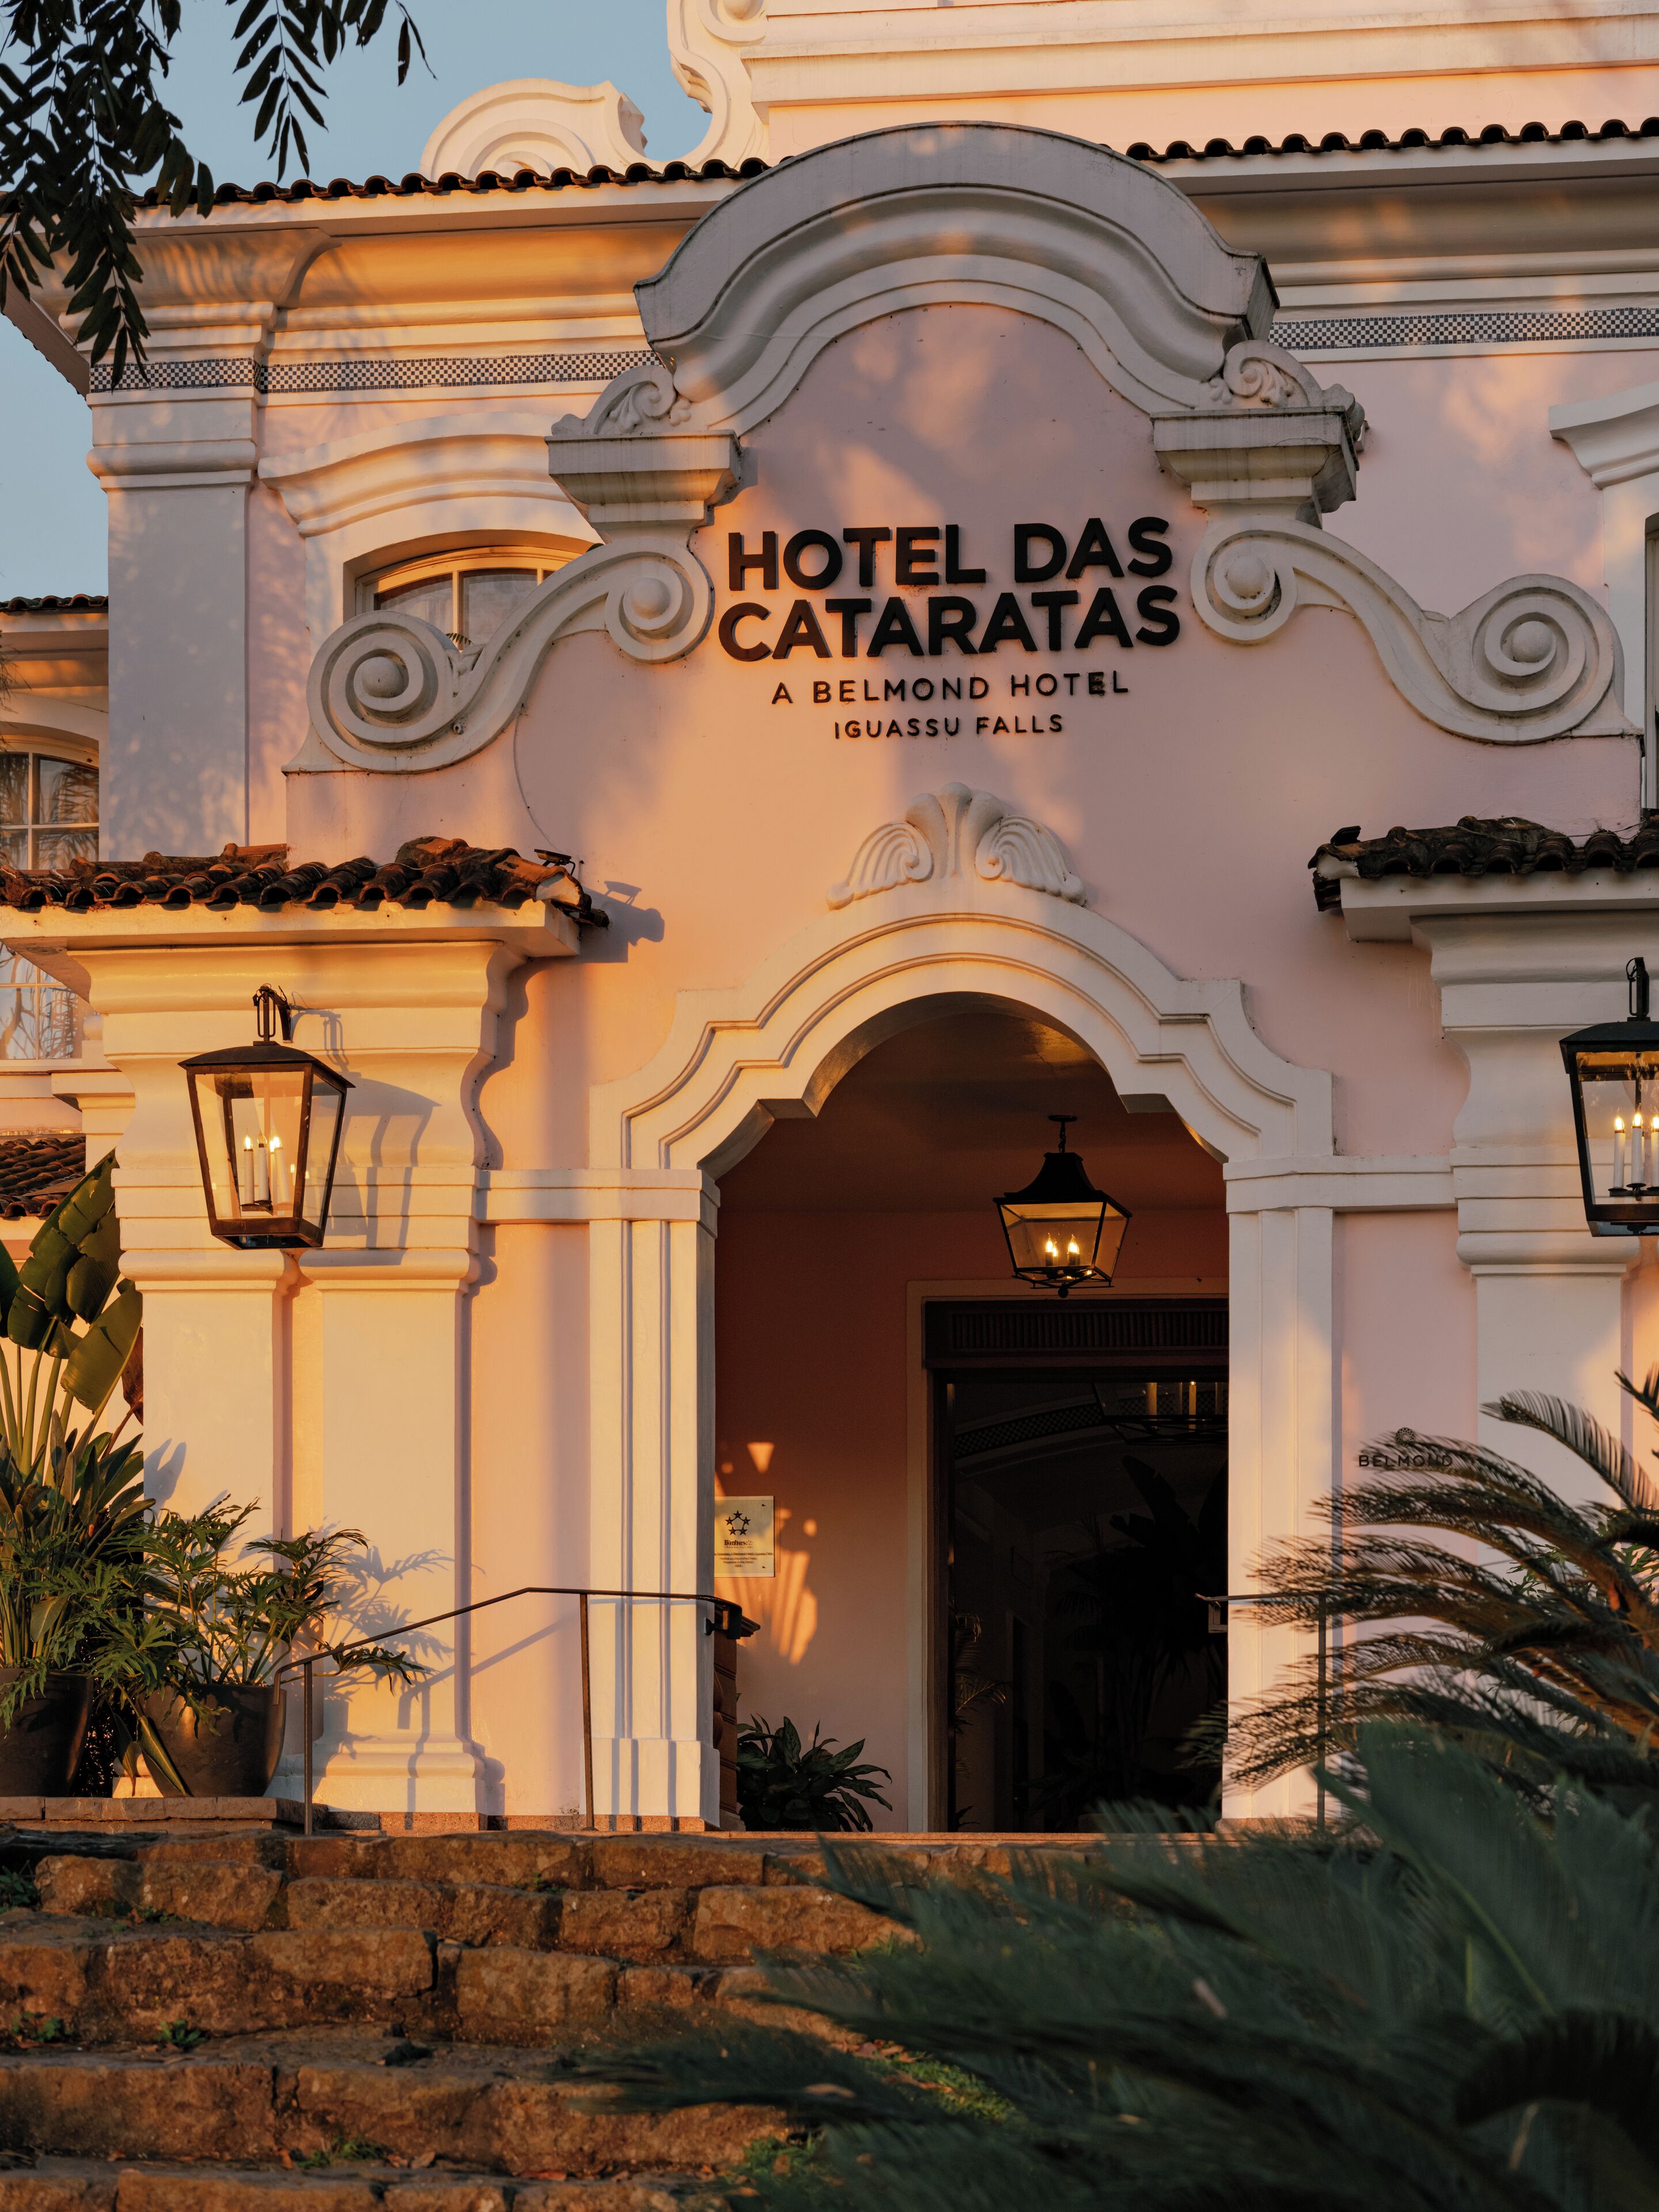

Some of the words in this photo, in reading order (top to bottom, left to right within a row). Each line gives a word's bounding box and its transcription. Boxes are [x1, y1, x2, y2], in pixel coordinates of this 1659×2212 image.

[728, 524, 986, 591] HOTEL
[1014, 517, 1173, 583] DAS
[718, 585, 1180, 661] CATARATAS
[771, 682, 793, 704] A
[813, 676, 989, 703] BELMOND
[1011, 671, 1128, 696] HOTEL
[835, 717, 960, 739] IGUASSU
[976, 714, 1062, 735] FALLS
